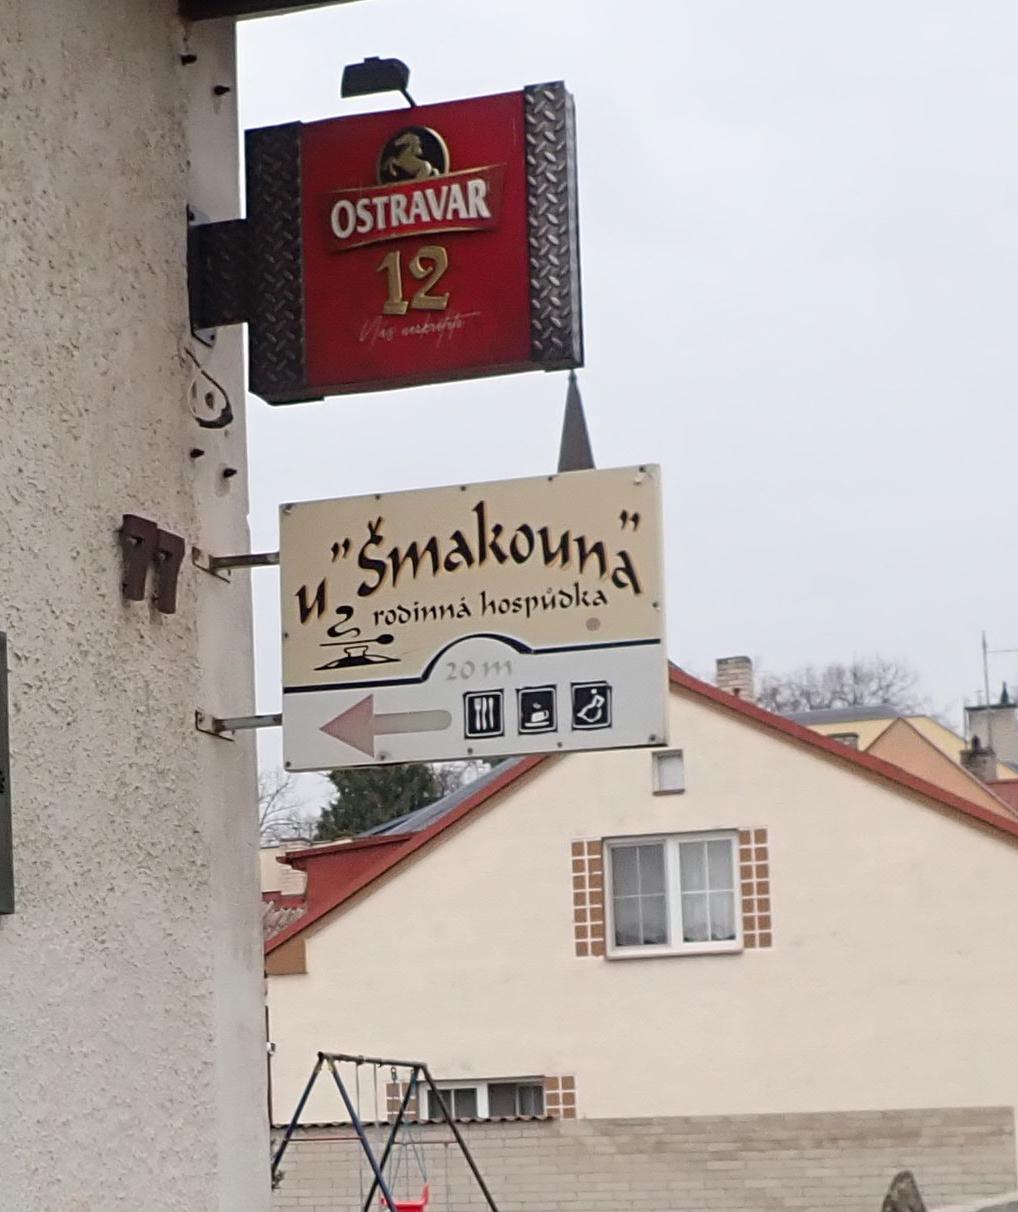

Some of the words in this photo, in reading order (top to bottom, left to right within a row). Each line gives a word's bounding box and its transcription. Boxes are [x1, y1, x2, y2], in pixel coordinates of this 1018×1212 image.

[331, 178, 491, 239] OSTRAVAR
[376, 245, 449, 315] 12
[373, 597, 471, 626] rodinná
[480, 582, 608, 618] hospůdka
